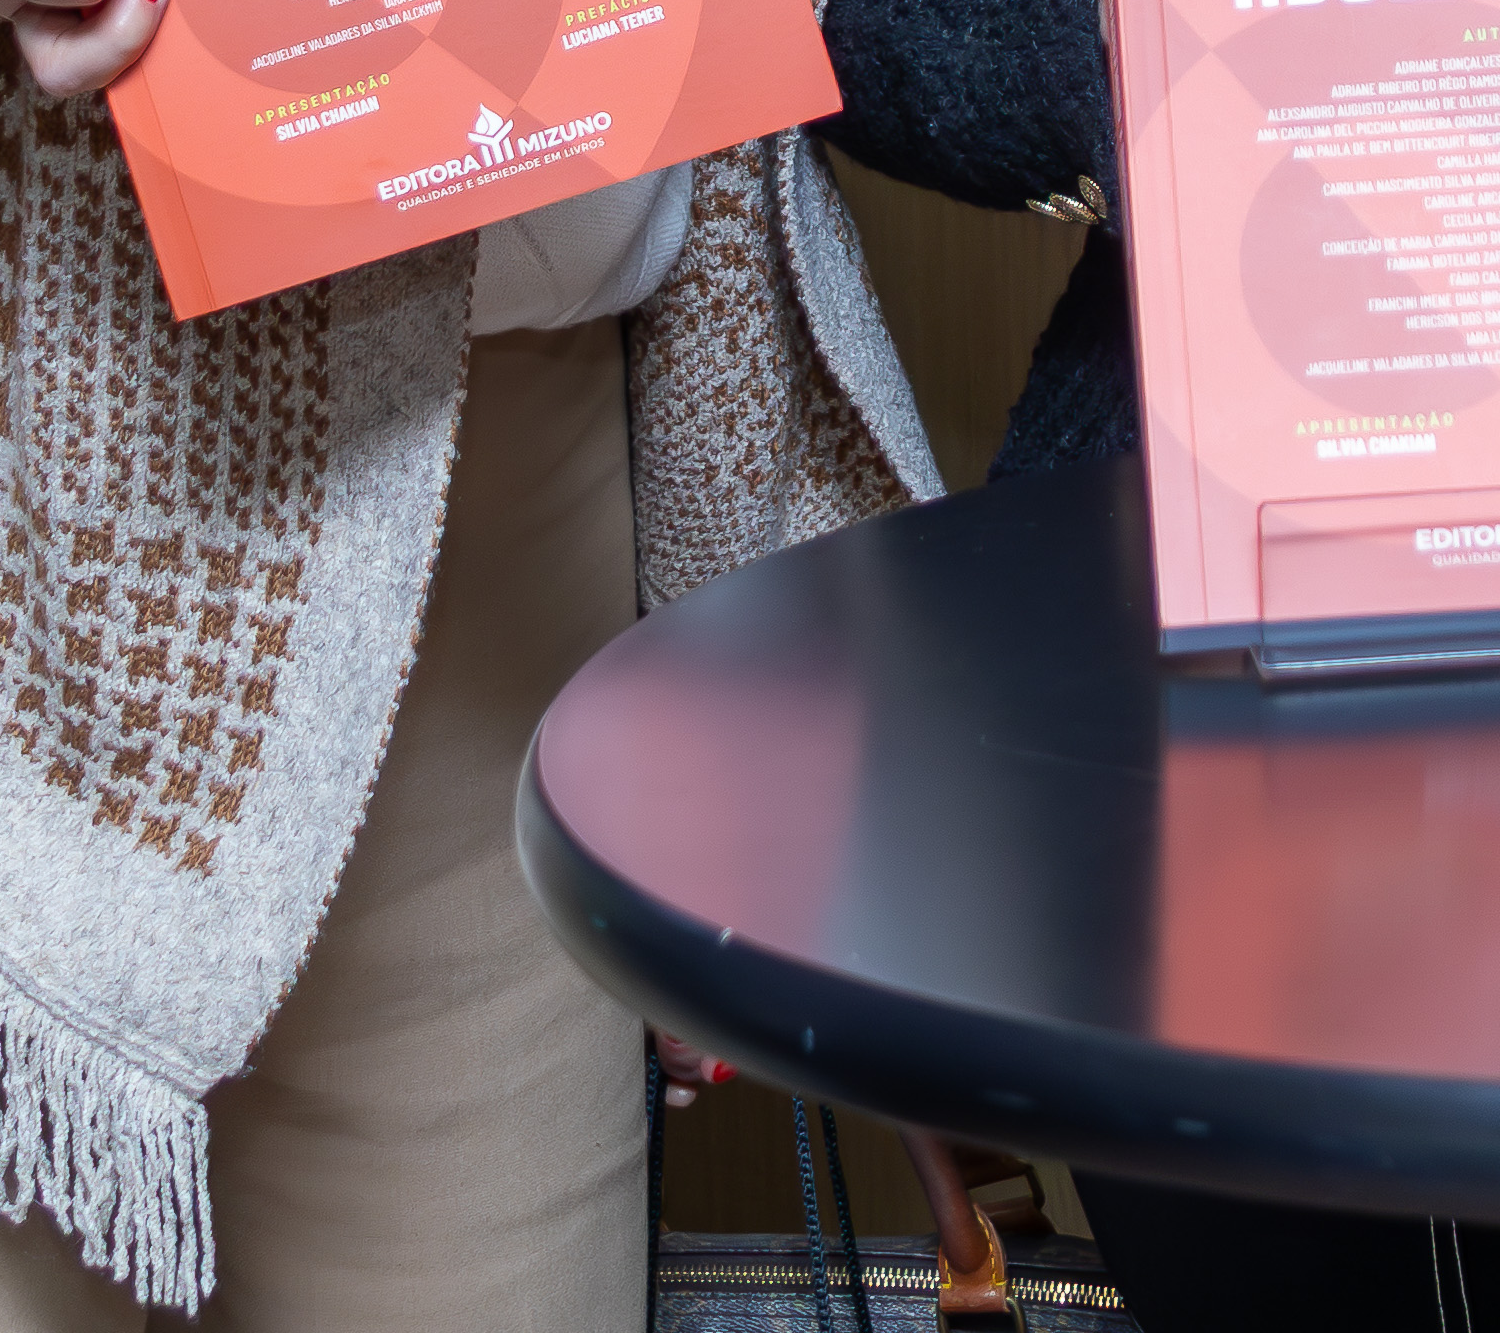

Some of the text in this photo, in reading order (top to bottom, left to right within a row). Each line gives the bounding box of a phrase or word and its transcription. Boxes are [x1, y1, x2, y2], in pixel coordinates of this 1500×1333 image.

[561, 5, 664, 49] LUCIANA TEMER
[255, 73, 389, 125] APRESENTAÇÃO
[275, 95, 379, 141] SILVIA CHAKIAN
[517, 111, 611, 156] MIZUNO
[377, 154, 481, 200] EDITORA
[397, 137, 604, 210] QUALIDADE E SERIEDADE EM LIVROS
[1296, 411, 1454, 435] APRESENTAÇÃO
[1316, 432, 1436, 458] SILVIA CHAKIAN
